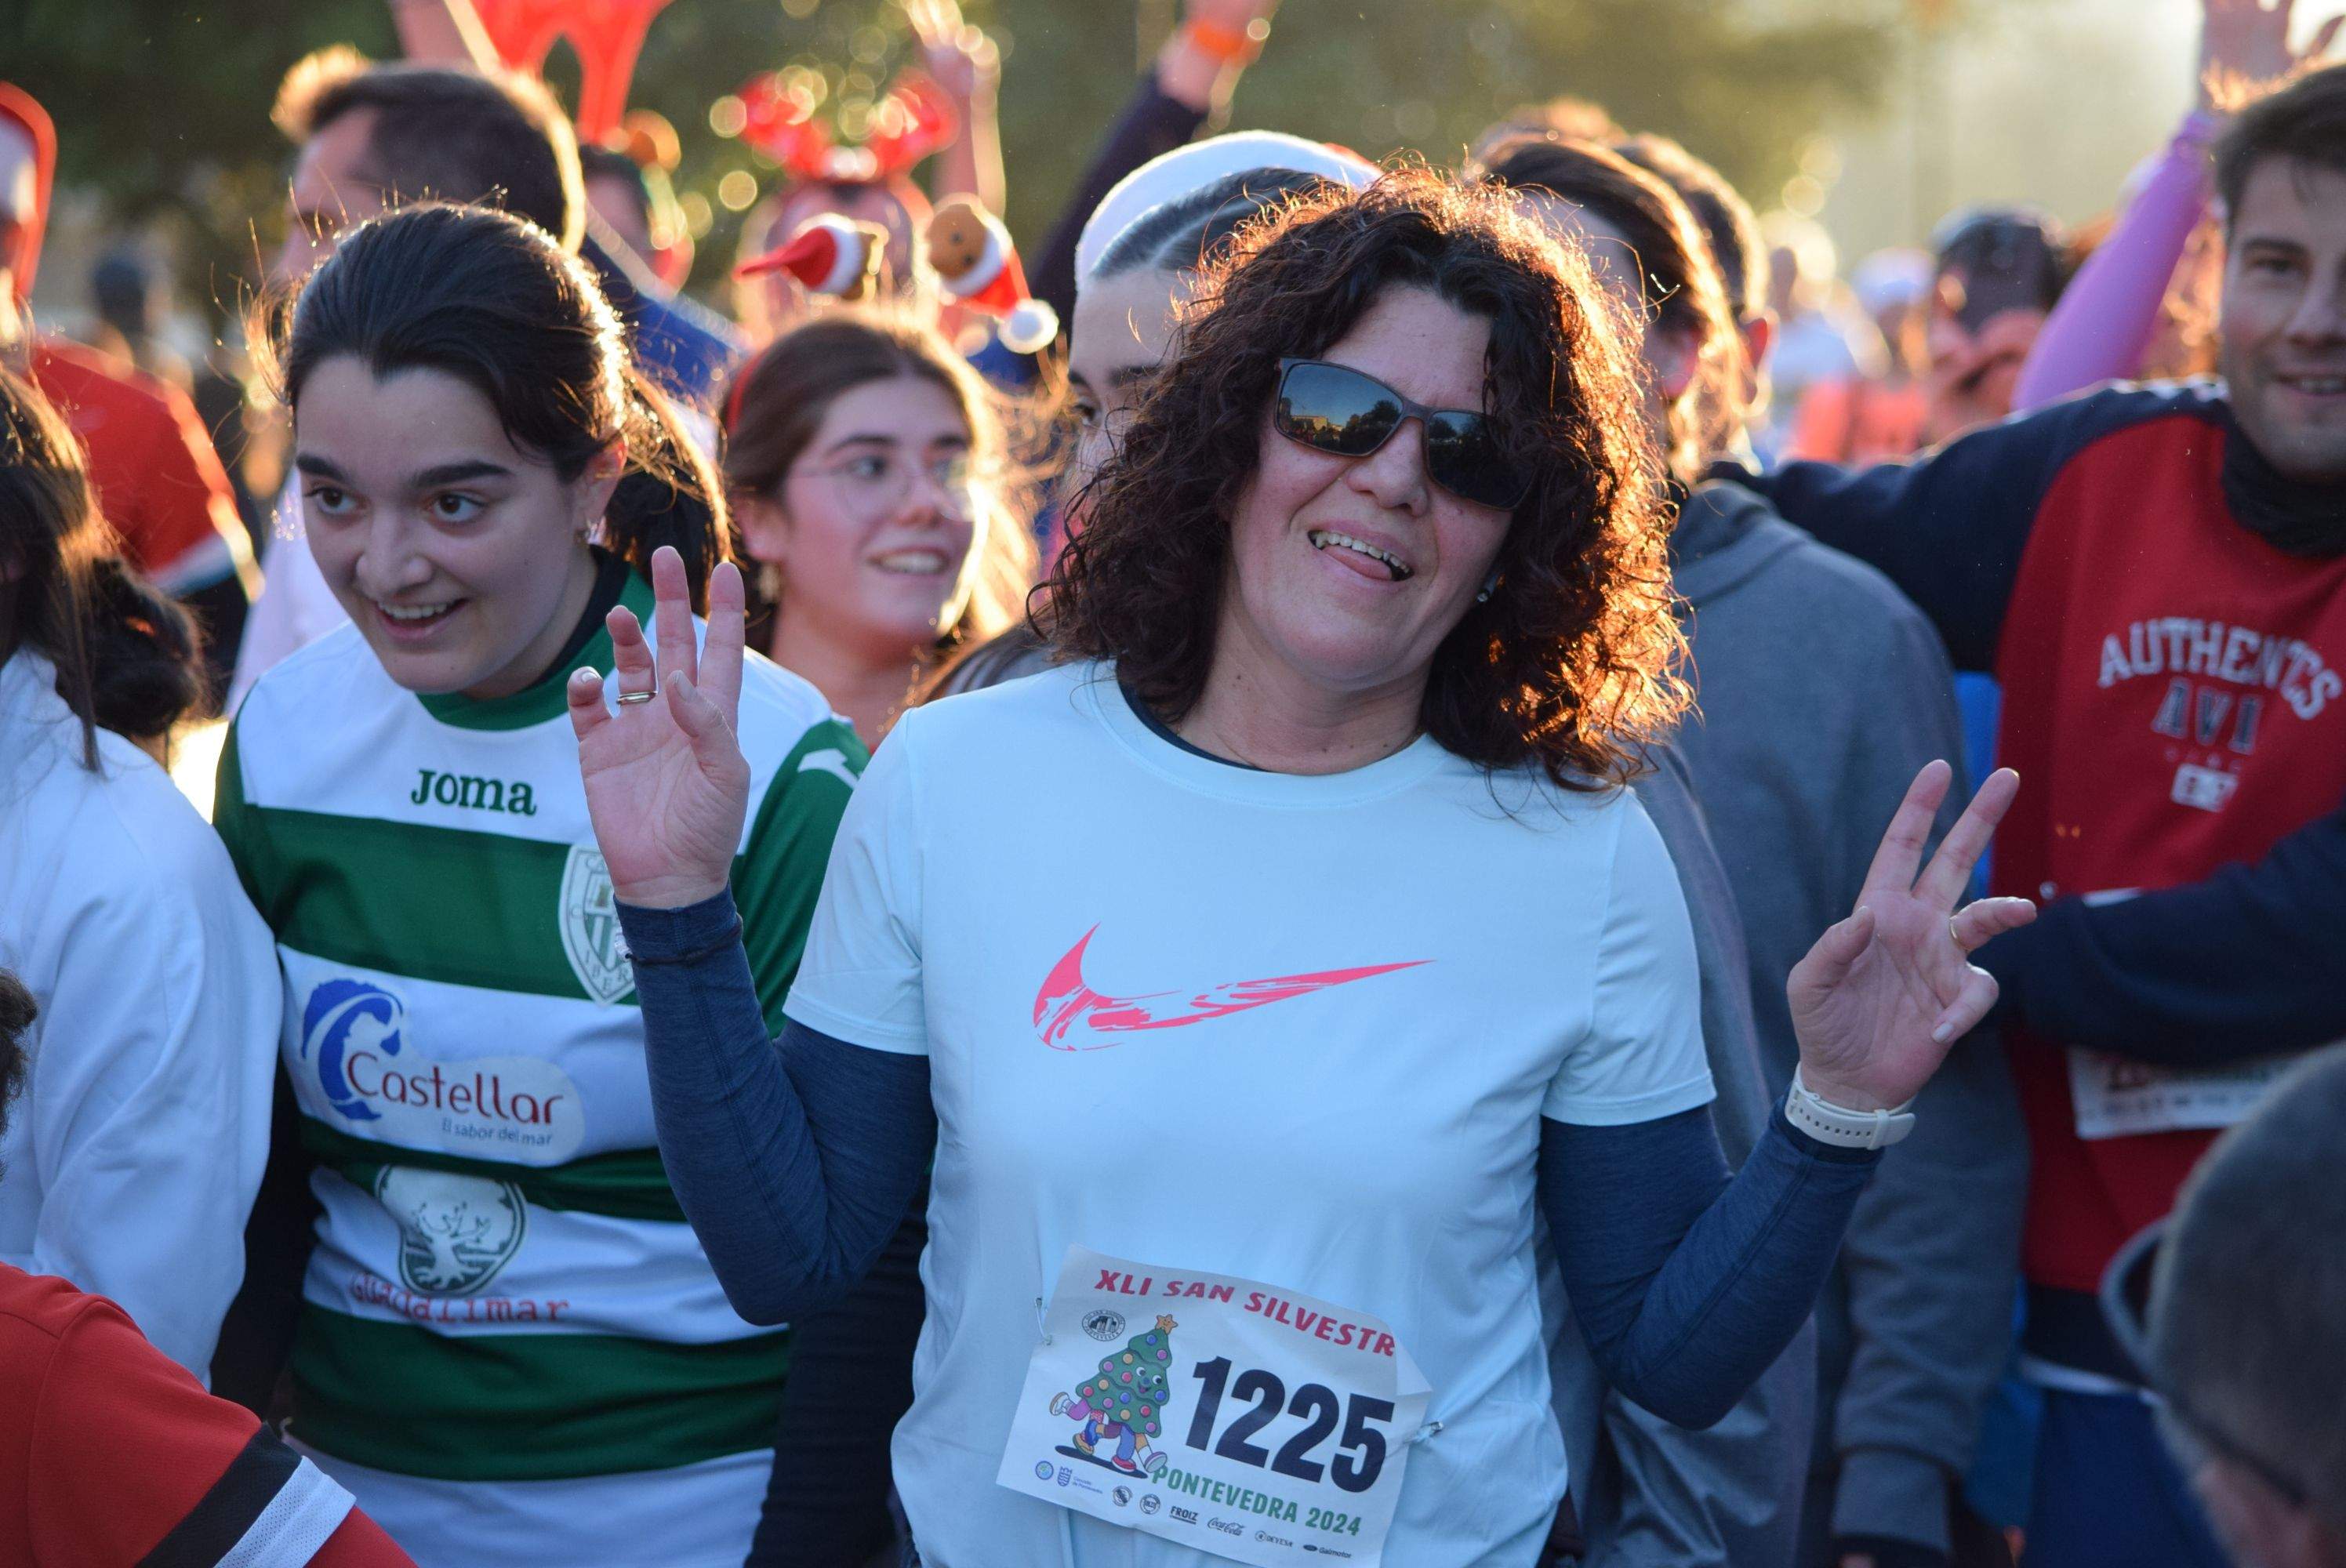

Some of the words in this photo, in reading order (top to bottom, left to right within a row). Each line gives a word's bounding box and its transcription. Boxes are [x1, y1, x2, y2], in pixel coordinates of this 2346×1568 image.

[347, 1051, 565, 1125] Castellar
[454, 1123, 495, 1140] sabor
[497, 1126, 520, 1142] del
[521, 1132, 553, 1146] mar
[1095, 1269, 1152, 1296] XLI
[1162, 1279, 1236, 1304] SAN
[1244, 1291, 1396, 1357] SILVESTR
[1186, 1356, 1396, 1494] 1225
[1151, 1465, 1299, 1523] PONTEVEDRA
[1304, 1506, 1362, 1537] 2024
[1171, 1505, 1199, 1522] FROIZ
